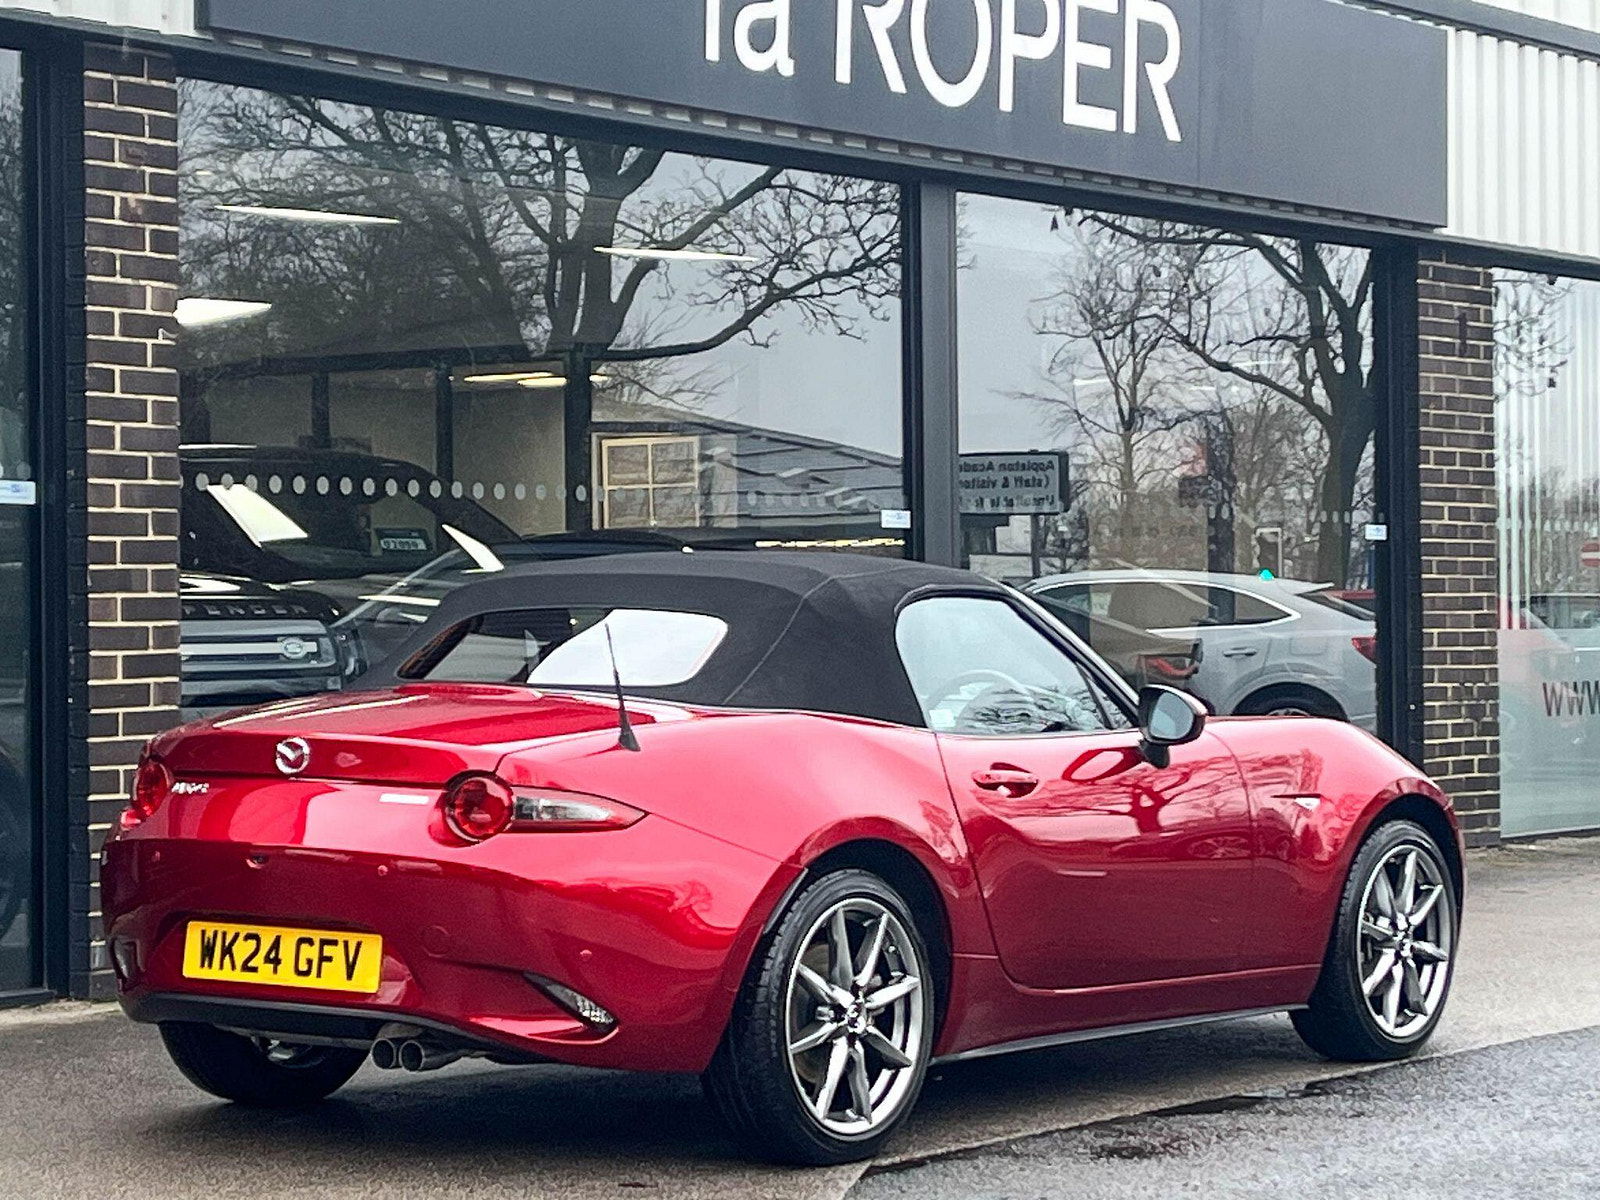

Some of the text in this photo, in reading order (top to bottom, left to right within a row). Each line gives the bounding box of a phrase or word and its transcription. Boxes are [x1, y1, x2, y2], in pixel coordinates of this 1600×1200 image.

[834, 0, 1182, 142] ROPER
[199, 928, 363, 982] WK24 GFV
